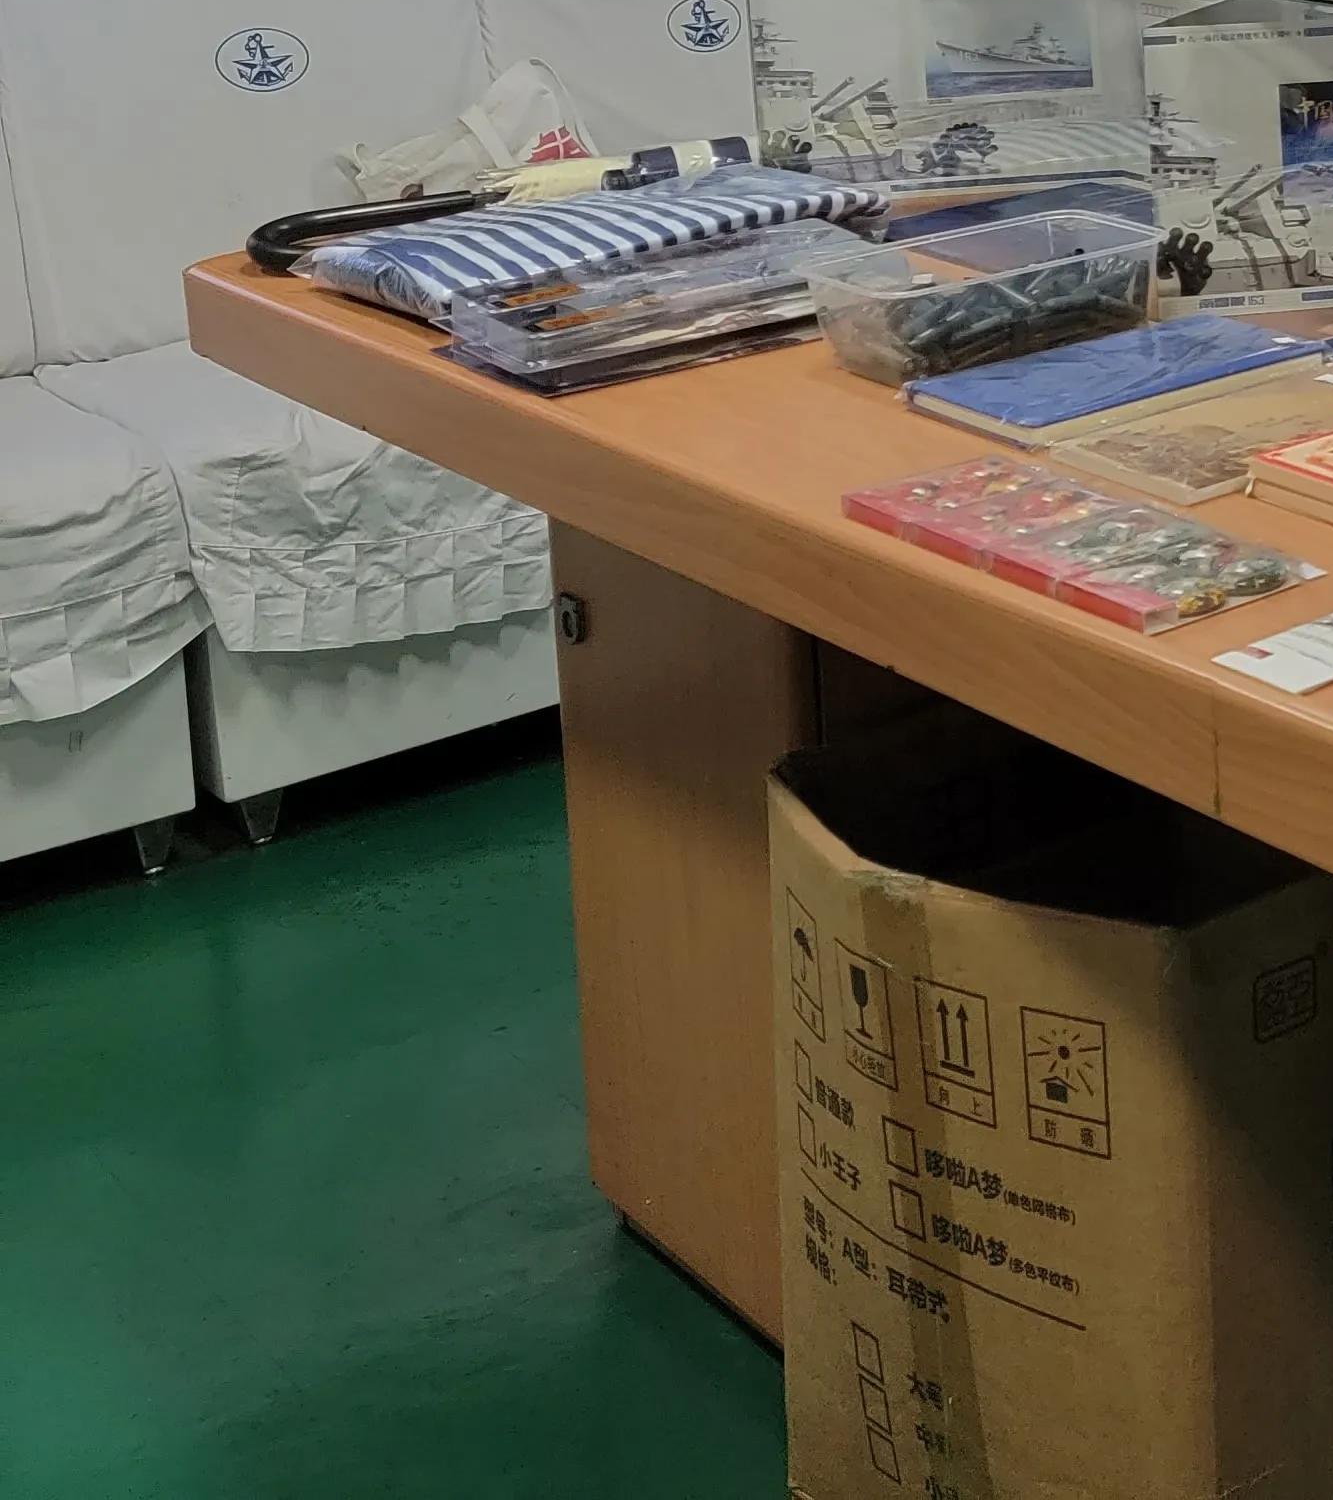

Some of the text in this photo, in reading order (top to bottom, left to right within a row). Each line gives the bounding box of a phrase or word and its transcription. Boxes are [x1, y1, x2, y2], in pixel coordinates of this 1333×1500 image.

[819, 1141, 862, 1191] 小王子
[925, 1148, 1003, 1200] 哆啦A梦
[932, 1213, 1008, 1266] 哆啦A梦
